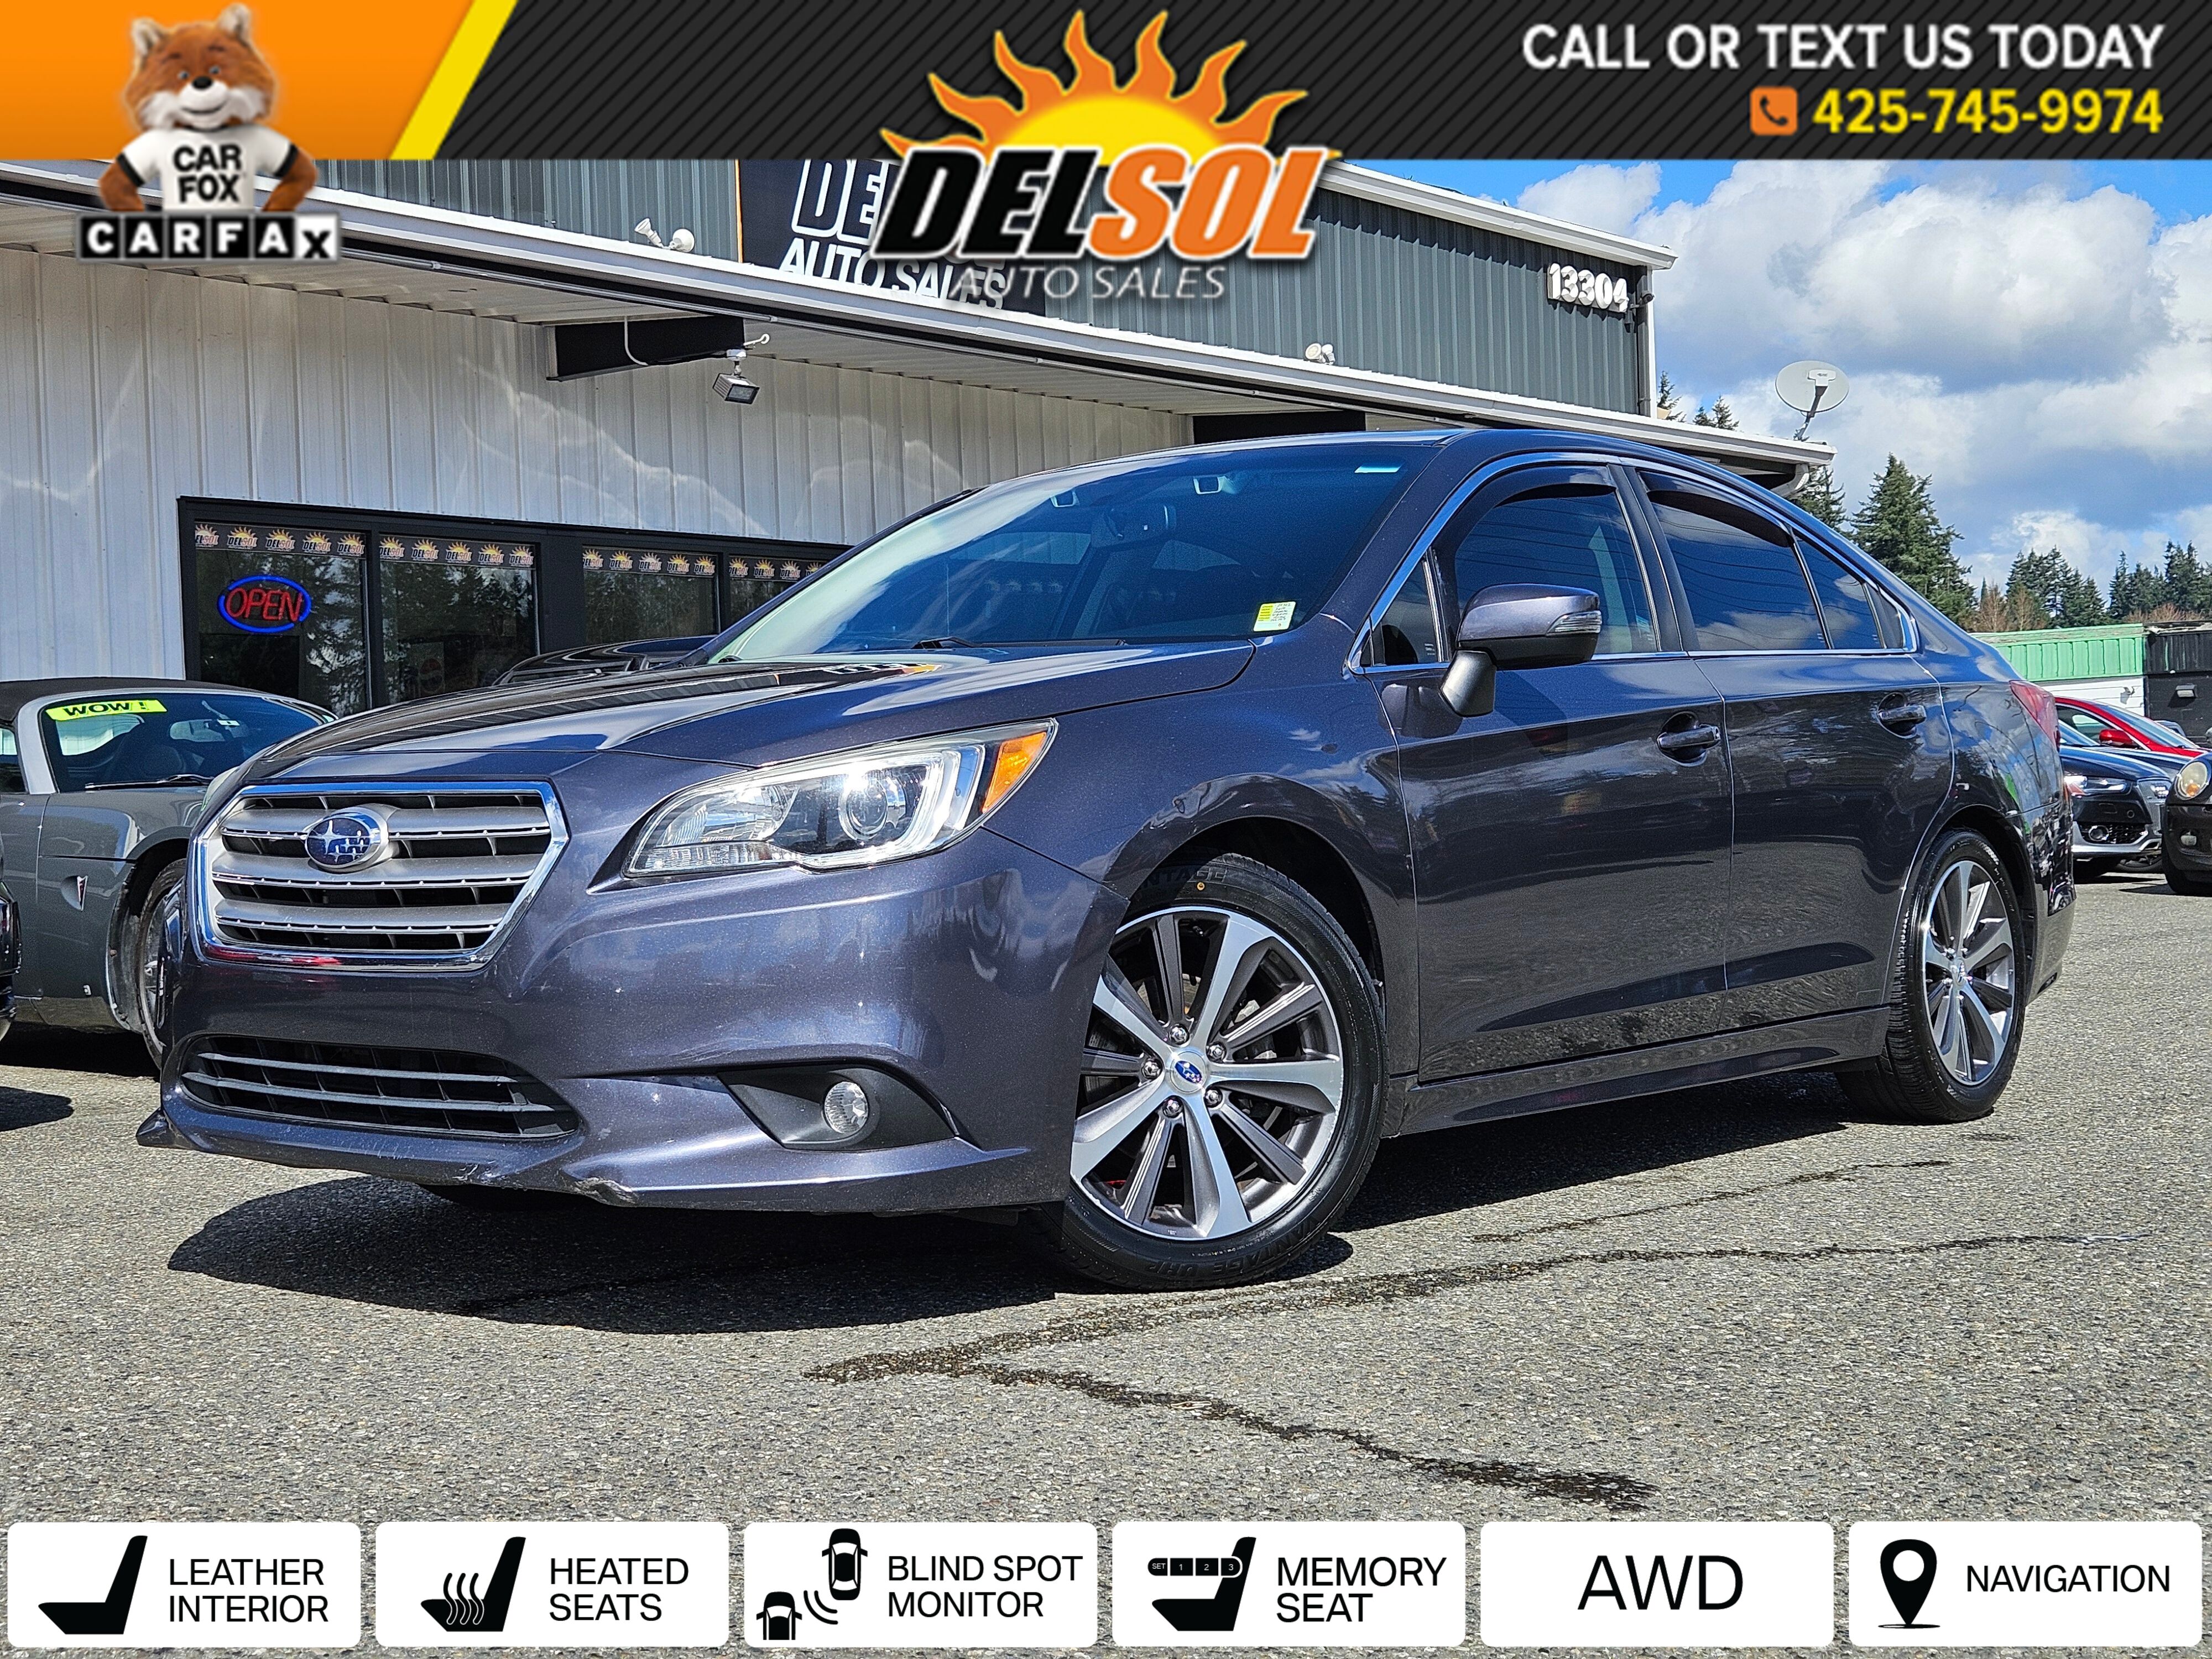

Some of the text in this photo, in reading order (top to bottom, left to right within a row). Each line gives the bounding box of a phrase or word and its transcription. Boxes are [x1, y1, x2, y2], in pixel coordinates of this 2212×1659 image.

[779, 237, 885, 289] AUTO
[1548, 263, 1629, 312] 13304
[196, 535, 218, 545] ELSOL
[226, 587, 302, 622] OPEN
[63, 702, 132, 716] WOW
